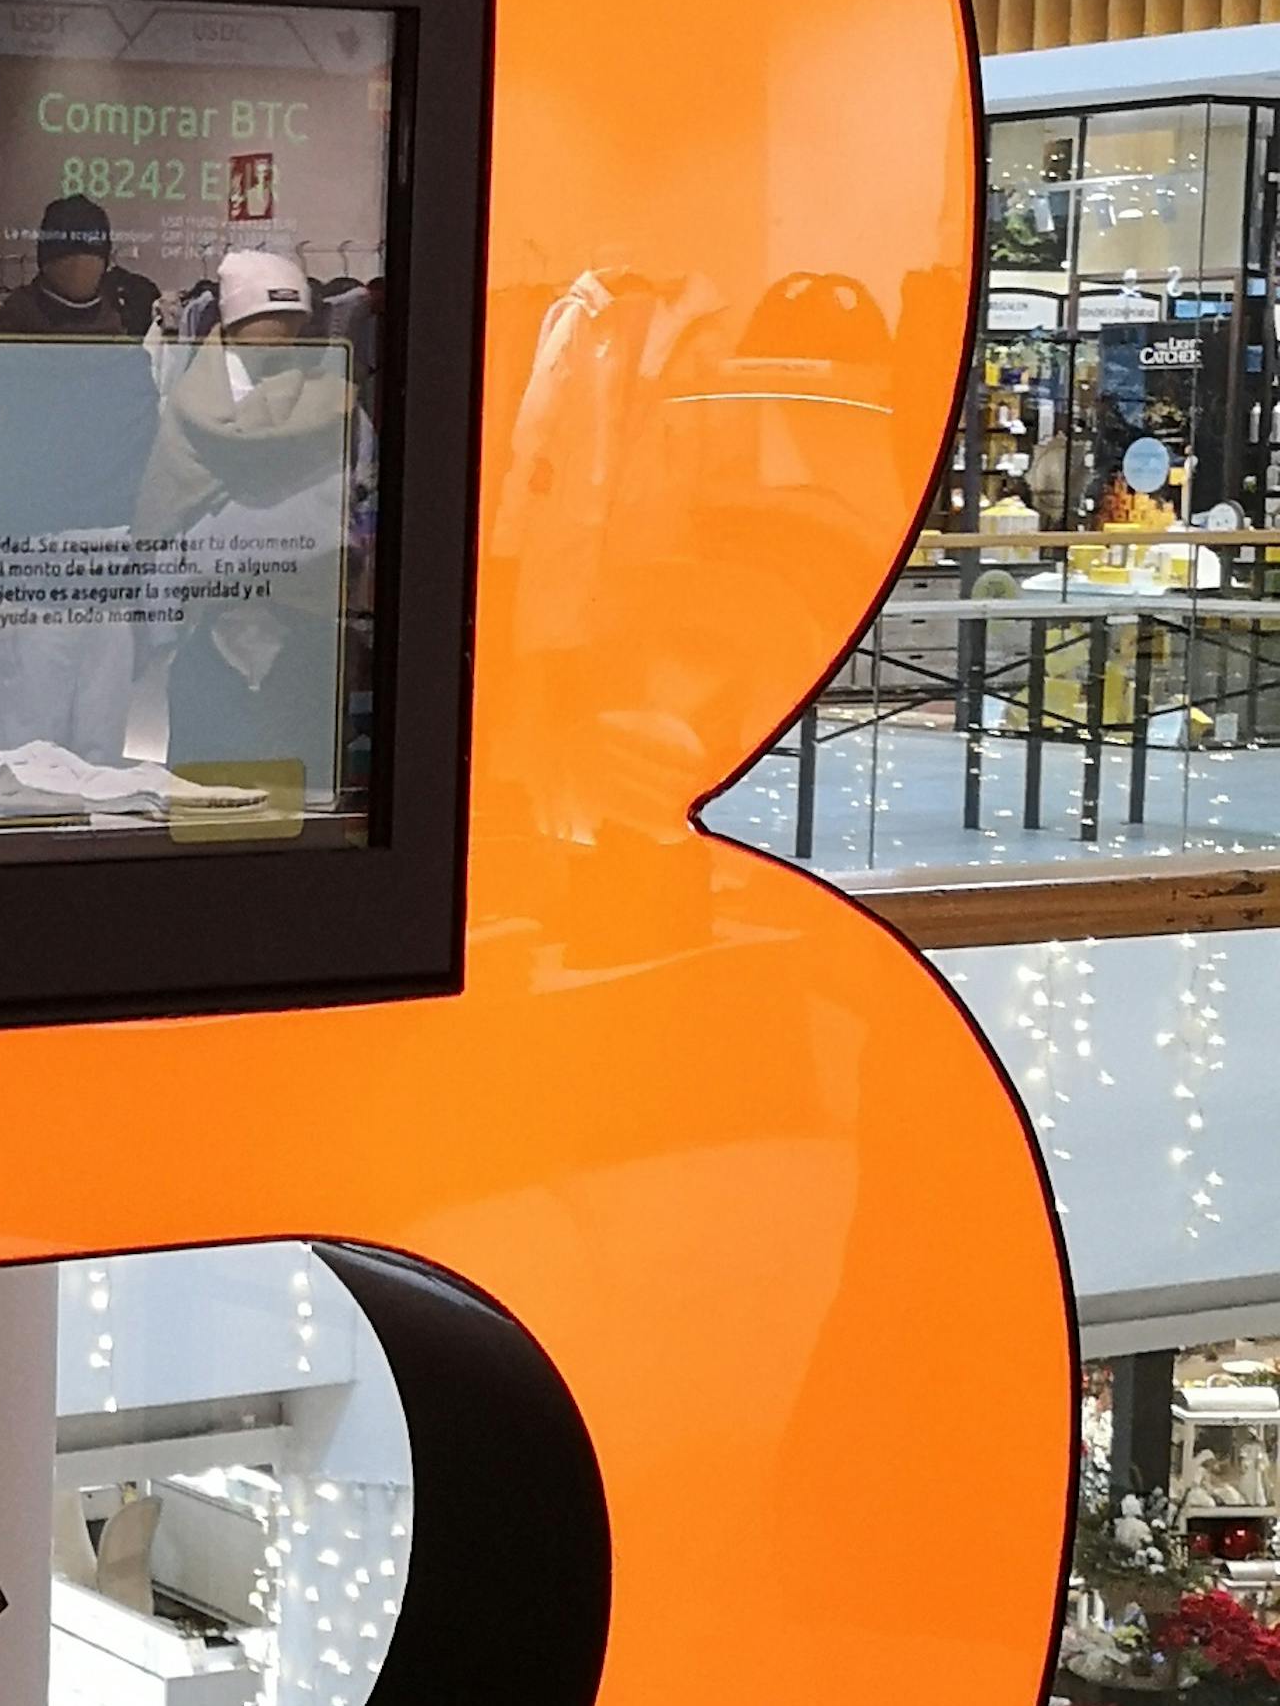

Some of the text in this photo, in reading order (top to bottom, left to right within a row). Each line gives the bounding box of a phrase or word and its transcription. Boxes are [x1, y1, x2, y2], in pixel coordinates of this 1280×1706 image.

[38, 92, 310, 144] Comprar BTC
[62, 156, 186, 201] 88242
[39, 540, 58, 553] Se
[62, 538, 131, 556] requiere
[209, 535, 225, 550] tu
[229, 535, 316, 550] documento
[8, 562, 61, 577] monto
[65, 559, 85, 576] de
[89, 560, 103, 575] la
[107, 556, 203, 576] transacción.
[214, 559, 234, 574] En
[237, 557, 298, 576] algunos
[50, 588, 68, 601] es
[71, 586, 142, 603] asegurar
[145, 583, 159, 598] la
[164, 580, 241, 602] seguridad
[242, 585, 253, 600] y
[255, 580, 271, 597] el
[42, 612, 62, 624] en
[67, 607, 104, 624] todo
[108, 606, 185, 623] momento
